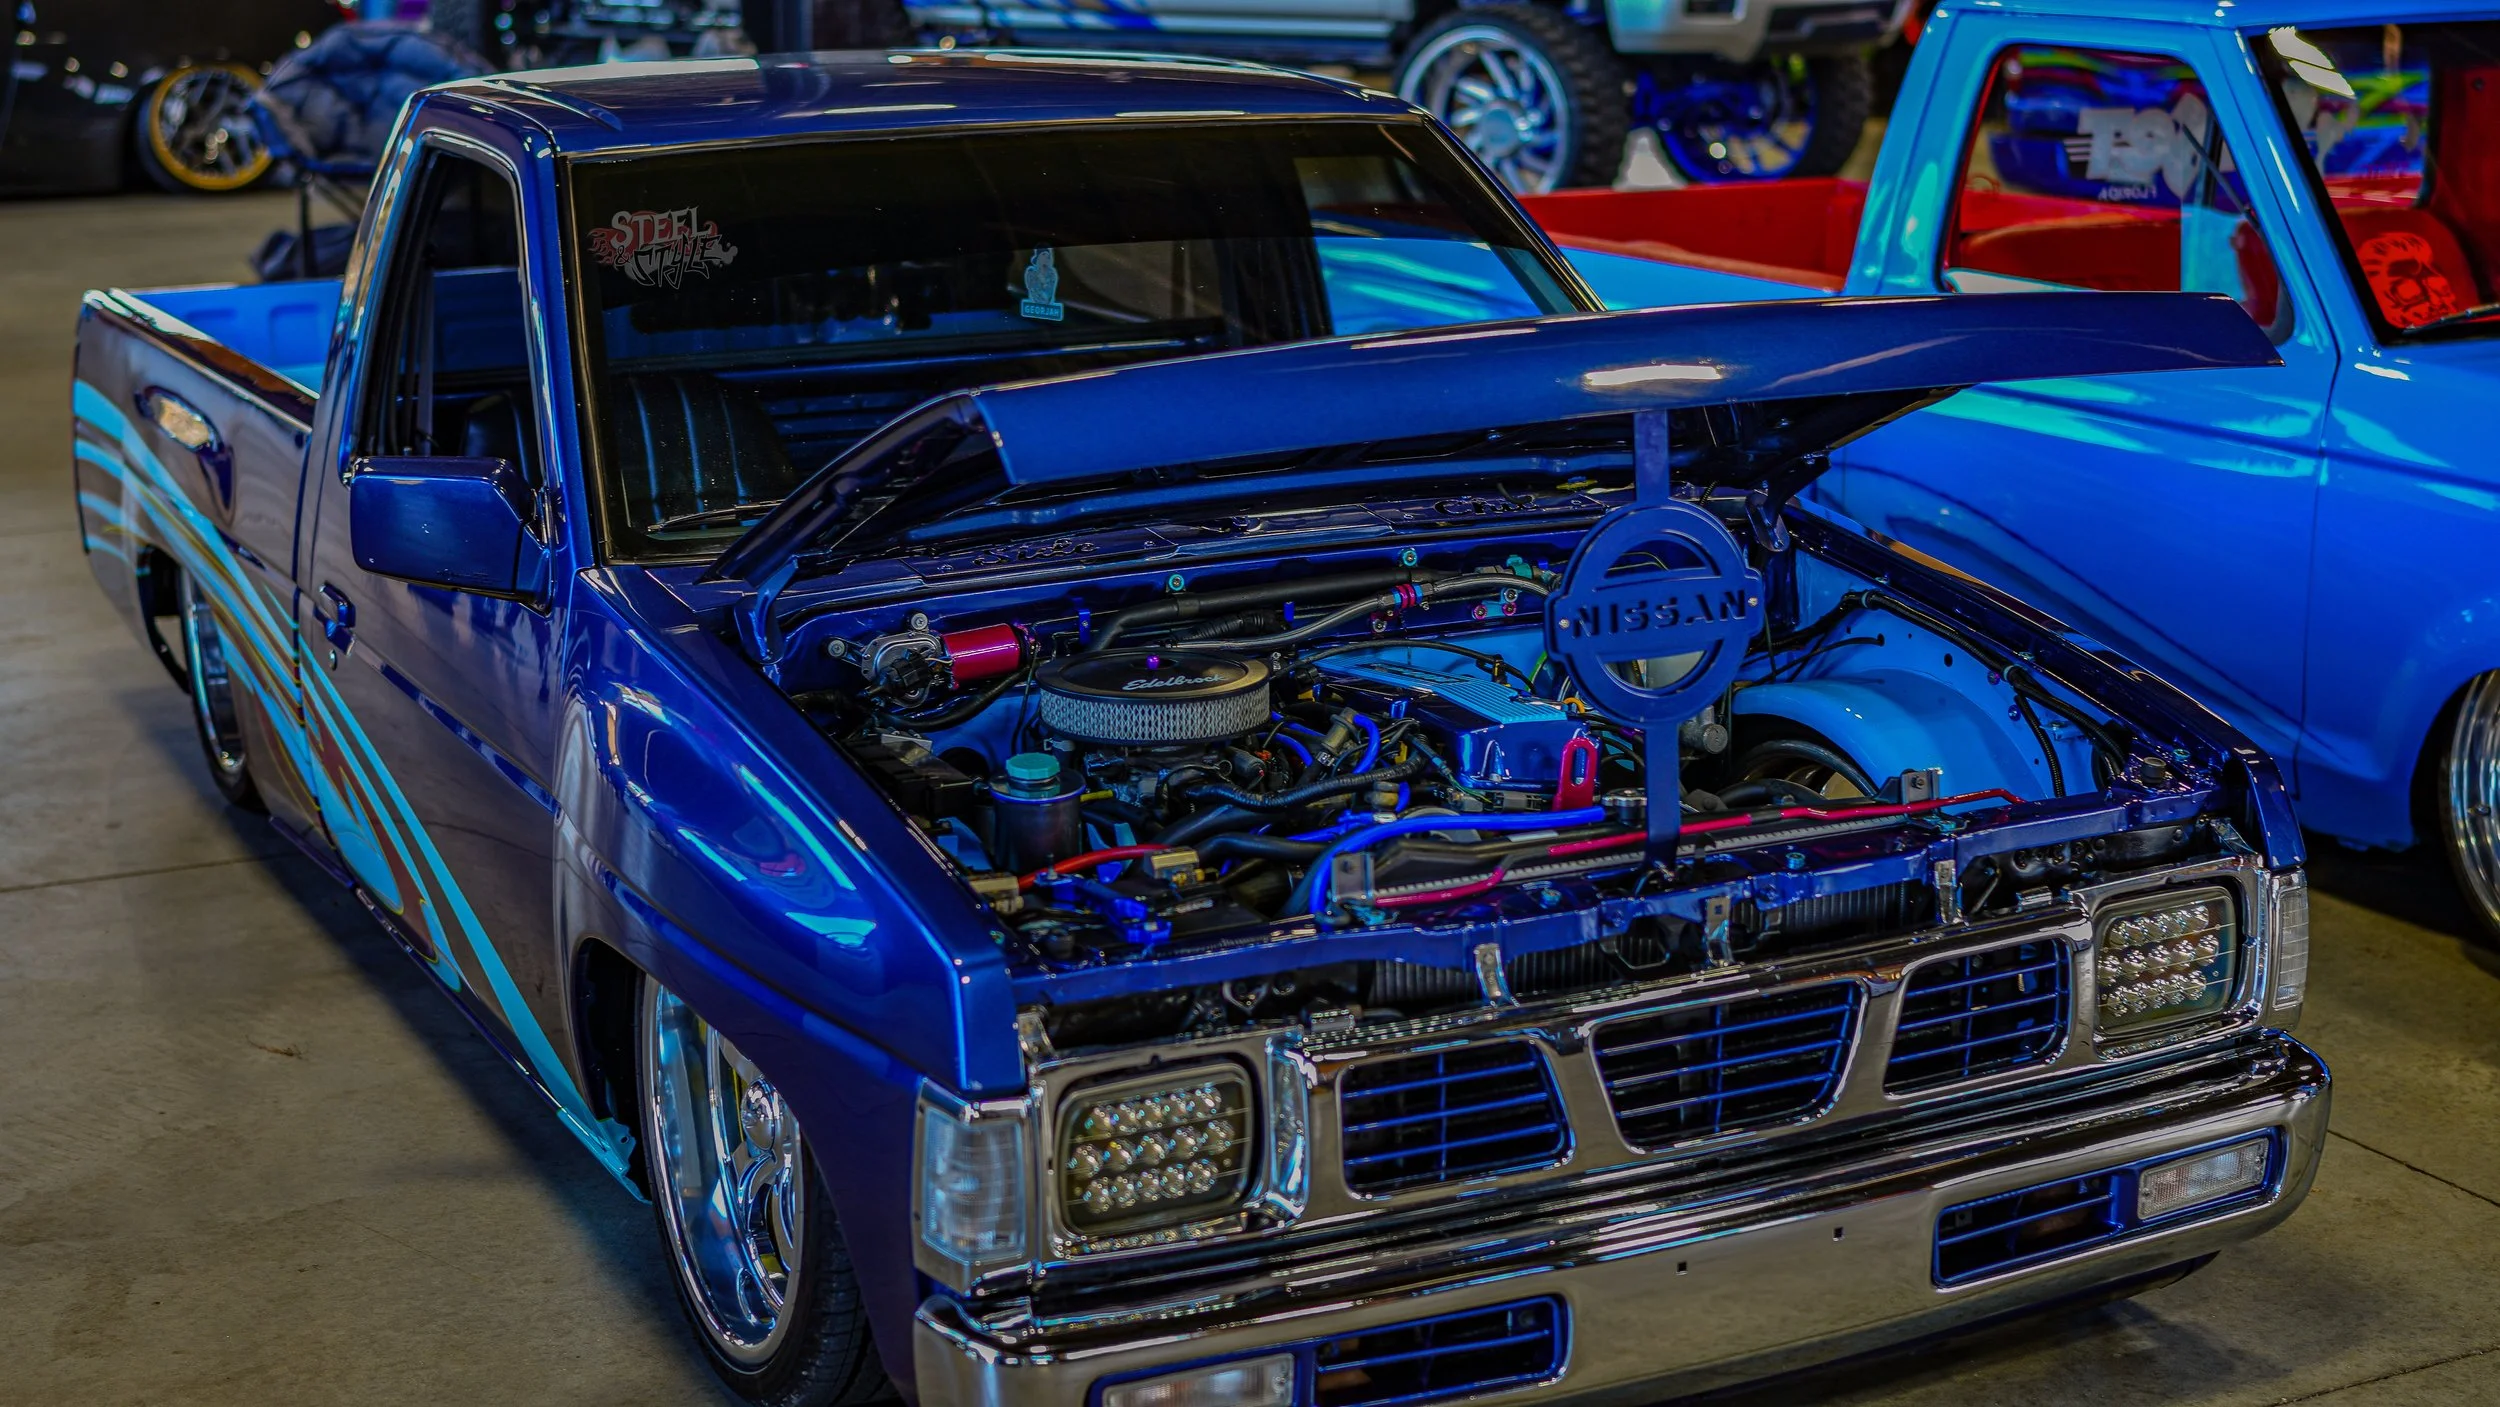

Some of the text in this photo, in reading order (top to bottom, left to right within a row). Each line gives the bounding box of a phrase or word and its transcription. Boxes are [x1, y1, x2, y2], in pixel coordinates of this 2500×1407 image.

[610, 206, 712, 249] STEEL
[615, 234, 723, 290] & STYLE
[1571, 588, 1748, 640] NISSAN
[1121, 673, 1226, 692] Edelbrock
